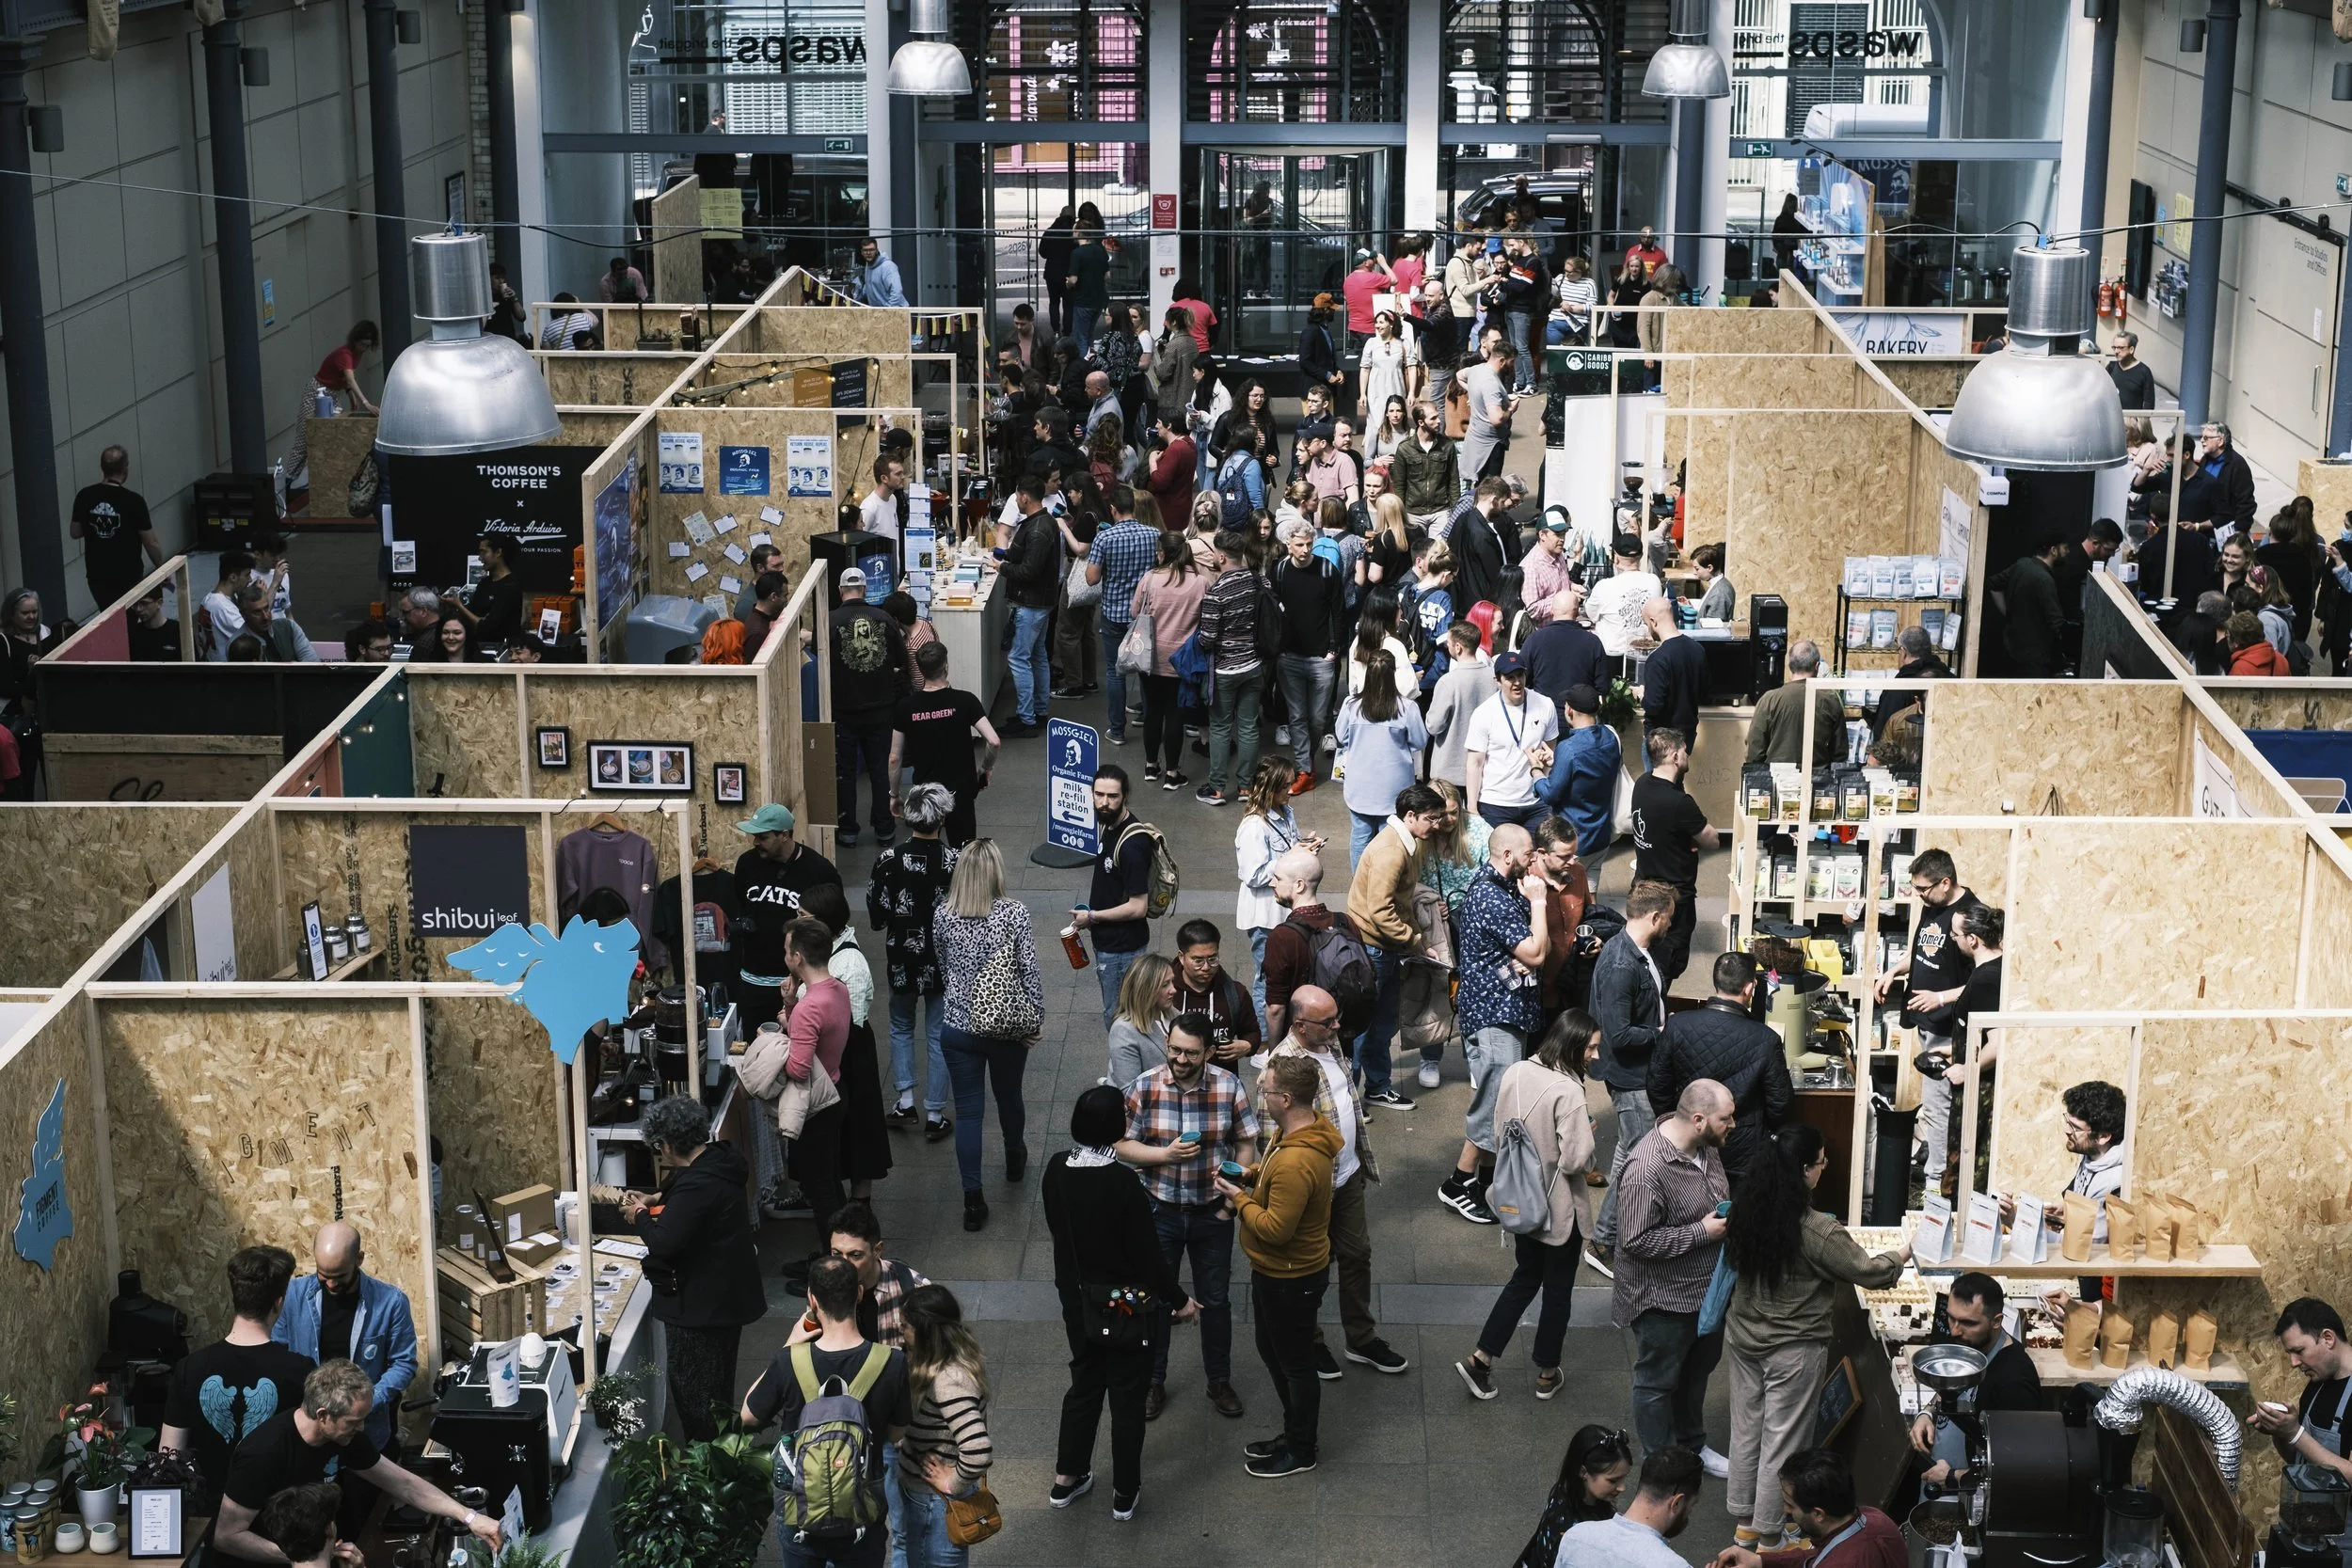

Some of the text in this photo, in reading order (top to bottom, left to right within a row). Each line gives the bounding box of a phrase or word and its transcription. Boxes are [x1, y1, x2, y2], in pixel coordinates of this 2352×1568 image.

[2294, 237, 2310, 255] Entrance
[2314, 245, 2328, 262] Studios
[2314, 260, 2328, 277] Offices
[1866, 341, 1928, 354] BAKERY
[1587, 361, 1609, 370] GOODS
[477, 465, 561, 476] THOMSON'S
[491, 478, 548, 489] COFFEE
[523, 520, 562, 533] Arduino
[913, 711, 930, 721] DEAR
[1052, 725, 1094, 747] MOSSGIEL
[1052, 764, 1093, 783] Organic Farm
[1063, 782, 1083, 794] milk
[1060, 790, 1086, 804] re-fill
[1057, 798, 1089, 815] station
[1052, 821, 1094, 841] /mossgielfarm
[746, 885, 801, 910] CATS
[421, 907, 495, 929] shibui
[497, 912, 517, 922] leaf
[388, 903, 400, 965] Strength
[36, 1180, 58, 1220] FIGMENT
[38, 1199, 59, 1233] COFFEE
